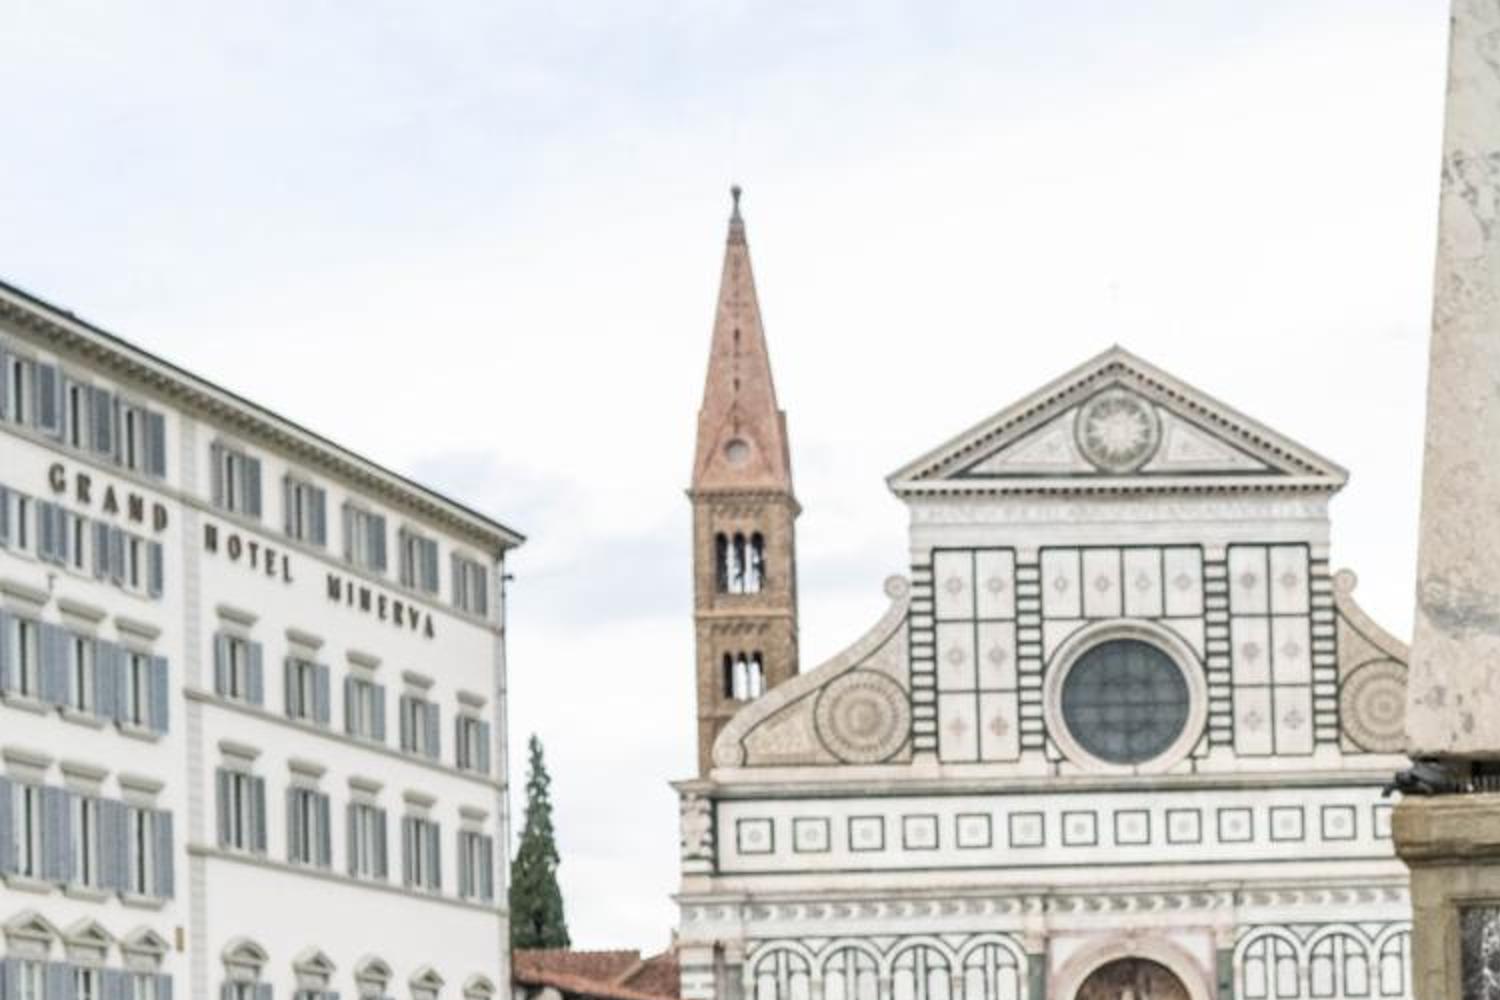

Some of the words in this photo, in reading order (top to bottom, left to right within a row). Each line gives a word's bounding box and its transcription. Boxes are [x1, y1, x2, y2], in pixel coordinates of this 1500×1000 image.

[49, 463, 167, 532] GRAND
[205, 523, 292, 583] HOTEL
[326, 573, 435, 639] MINERVA
